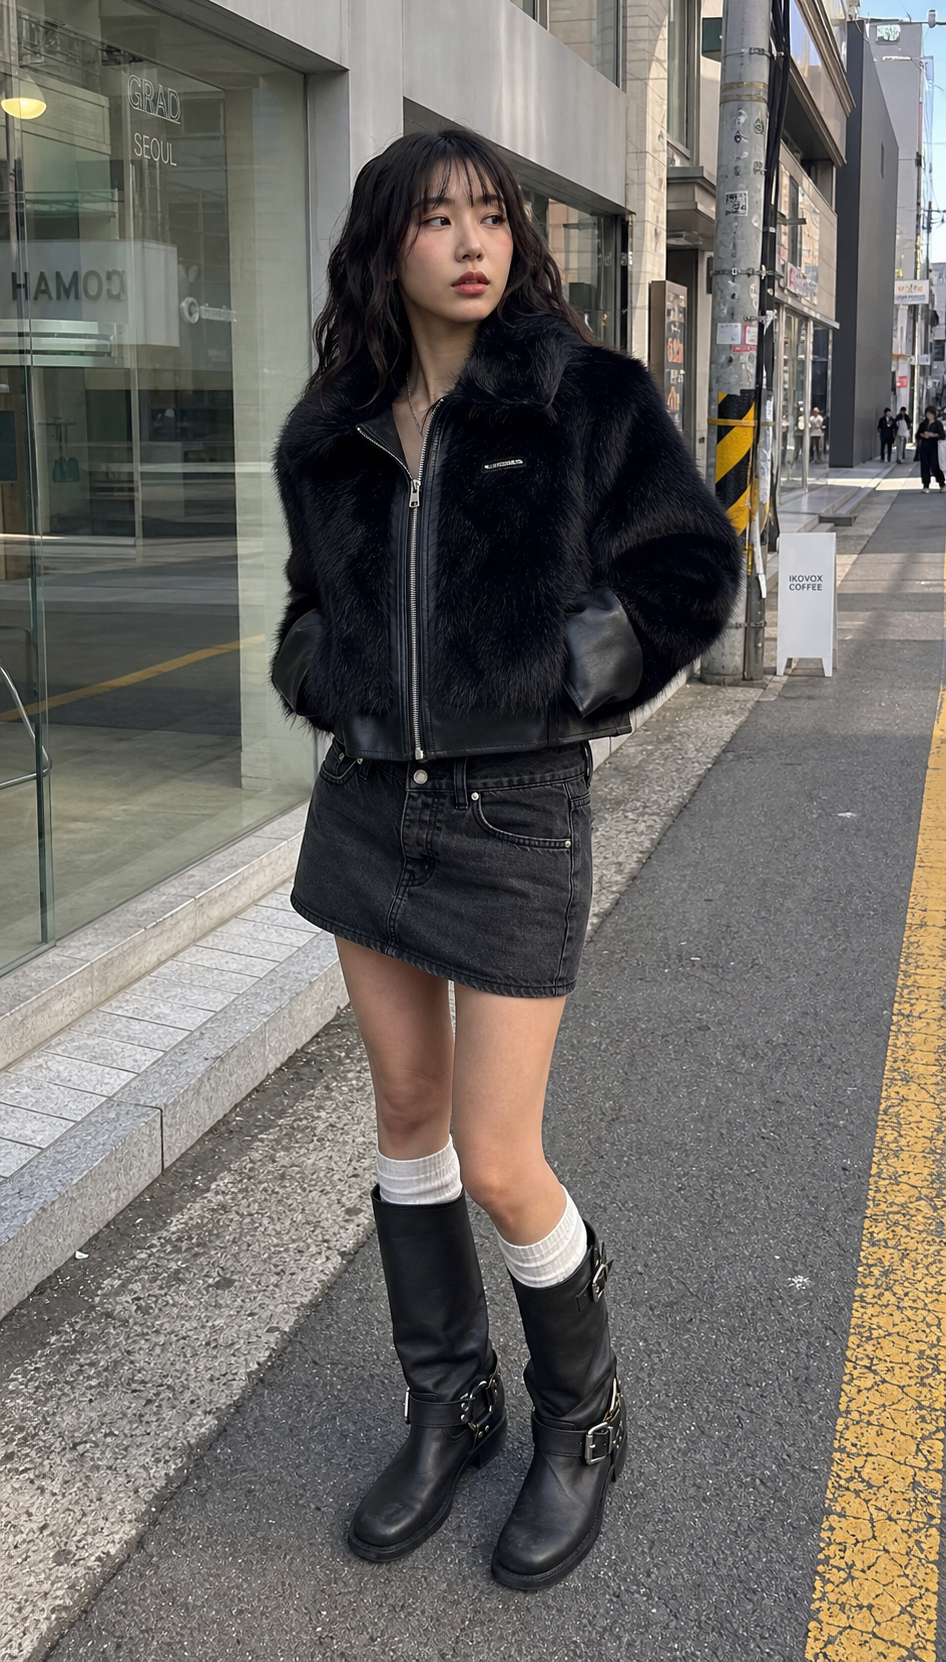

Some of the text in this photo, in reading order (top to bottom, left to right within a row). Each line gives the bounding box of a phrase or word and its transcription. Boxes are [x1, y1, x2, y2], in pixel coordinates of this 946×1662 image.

[128, 74, 181, 121] GRAD
[133, 132, 177, 167] SEOUL
[788, 574, 823, 583] IKOVOX
[788, 583, 823, 591] COFFEE
